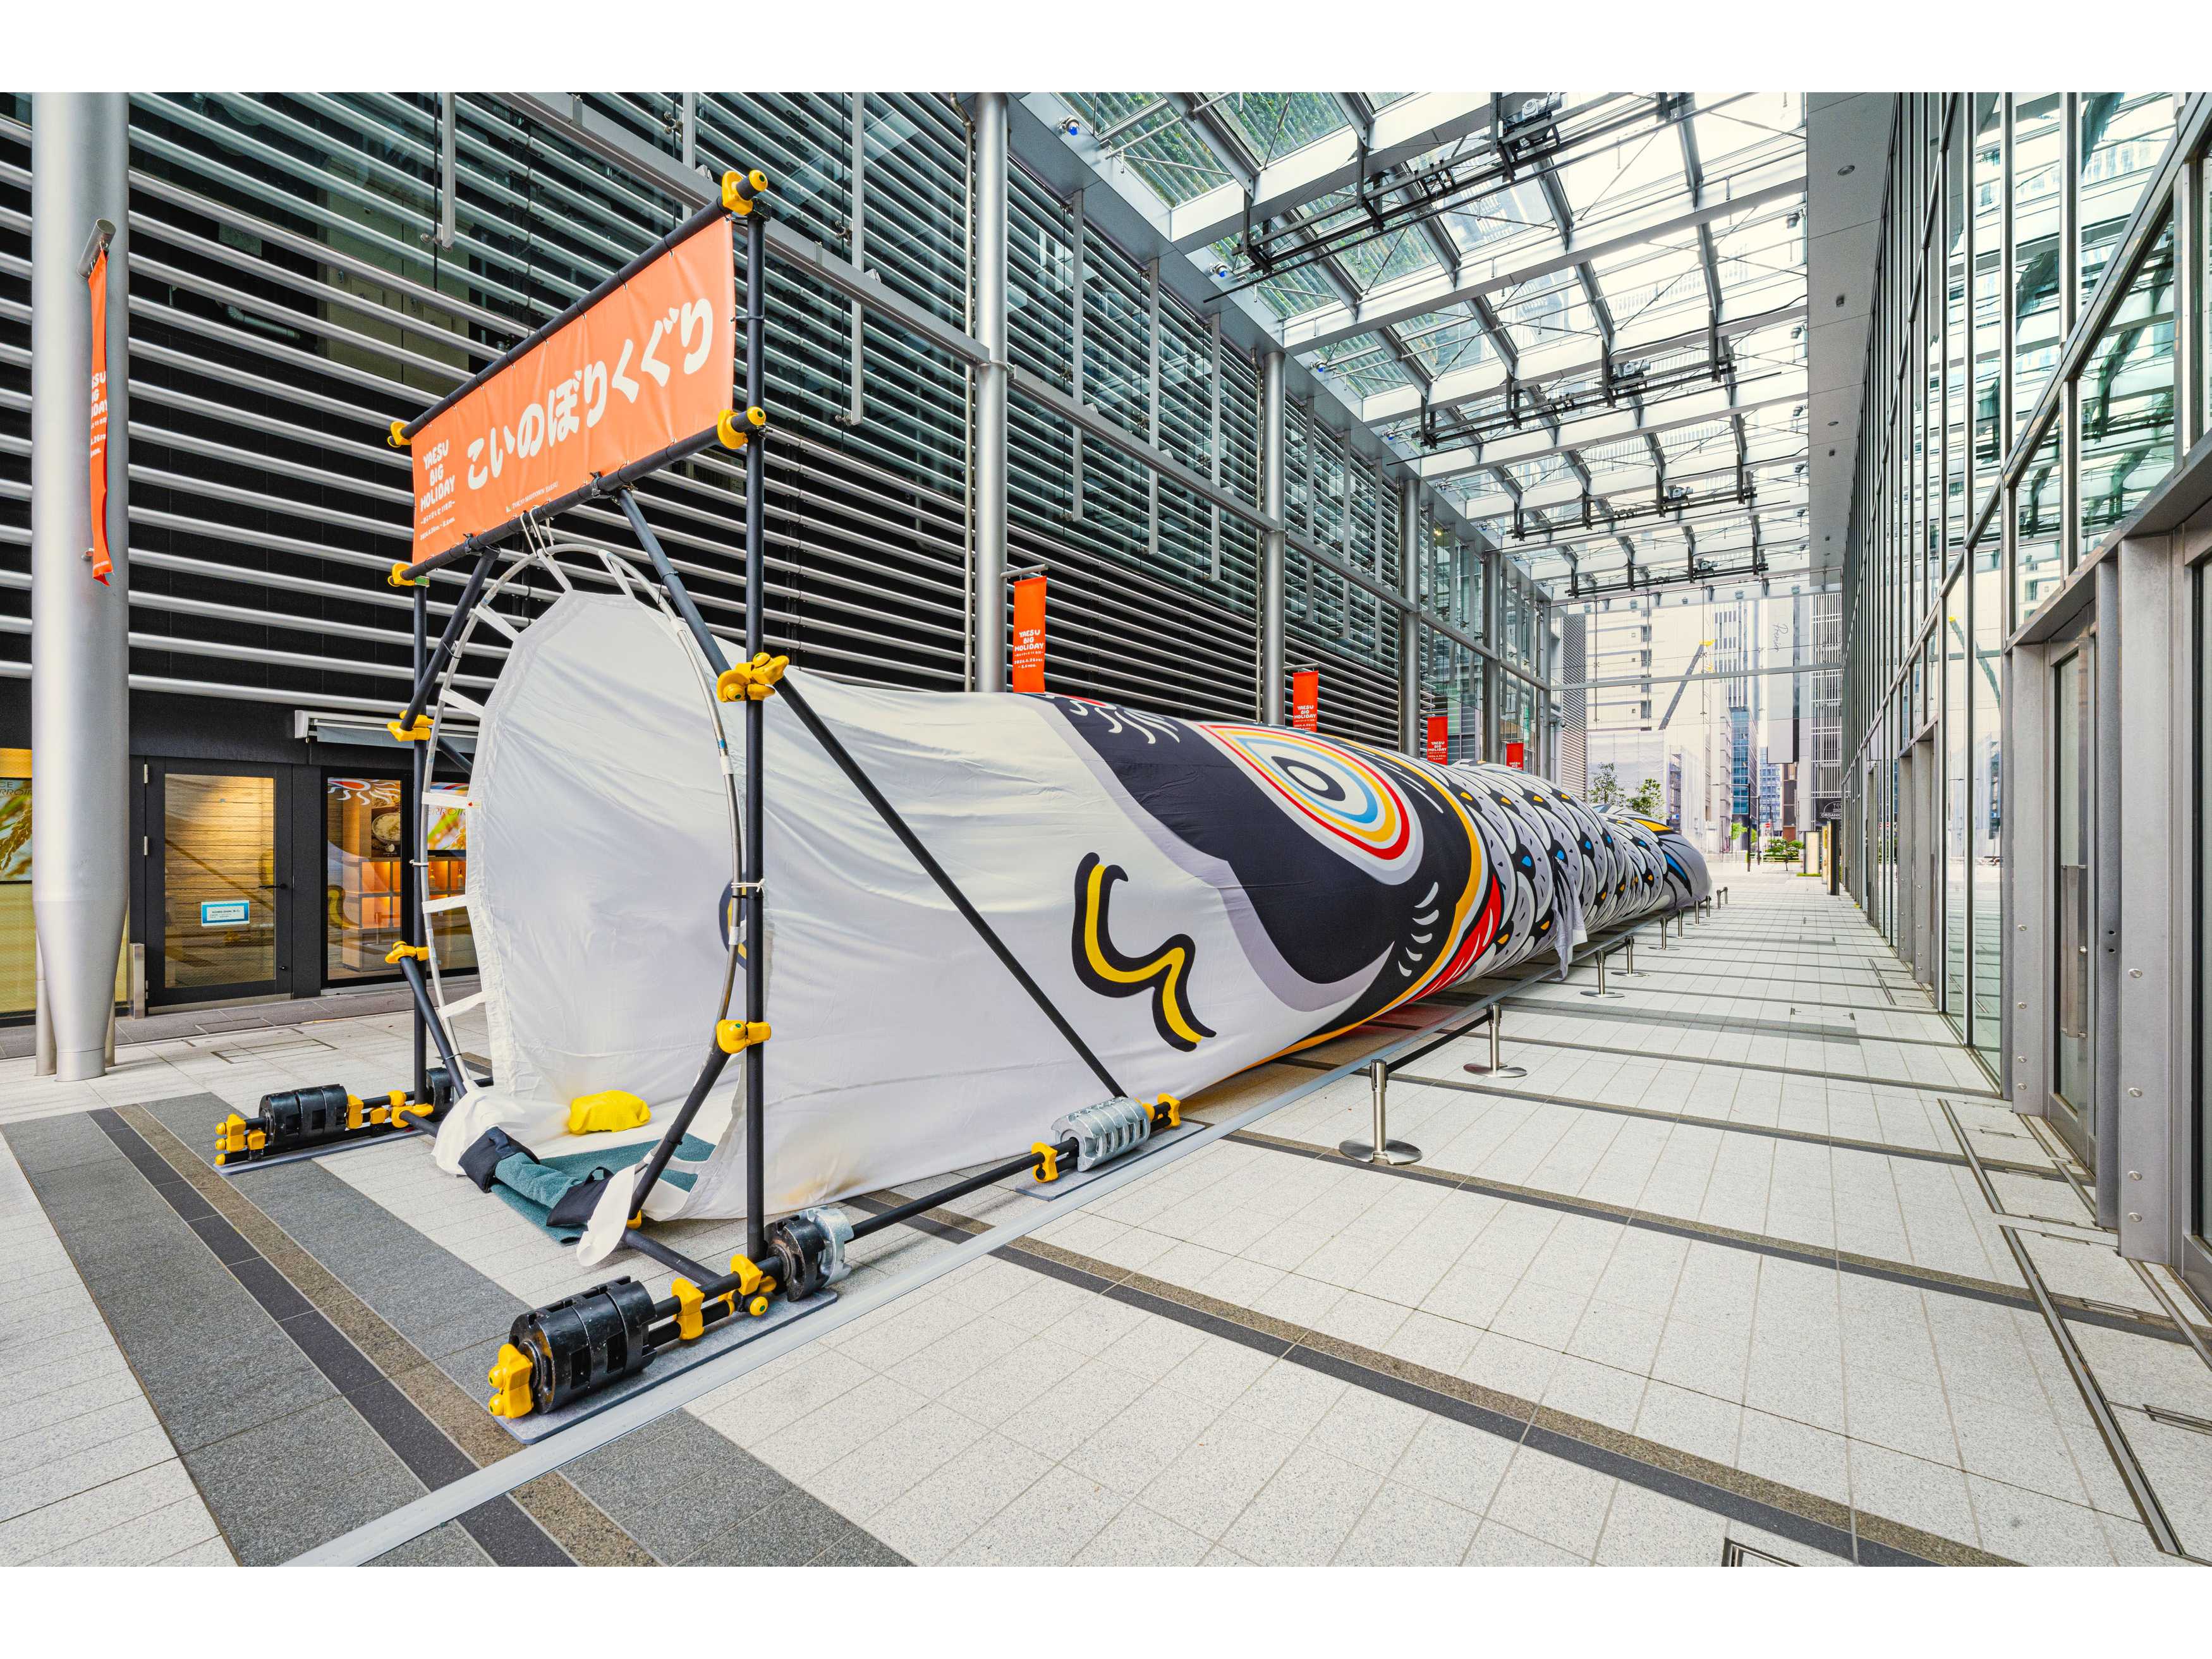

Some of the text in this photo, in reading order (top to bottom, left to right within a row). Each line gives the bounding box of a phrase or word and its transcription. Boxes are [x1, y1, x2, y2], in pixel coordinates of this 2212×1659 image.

[468, 298, 713, 490] こいのぼりくぐり
[423, 439, 449, 470] YAESU
[430, 464, 444, 486] BIG
[420, 475, 455, 512] HOLIDAY
[512, 480, 558, 509] TOKYO MIDTOWN YAESU
[1014, 643, 1043, 652] HOLIDAY
[1019, 629, 1040, 638] YAESU
